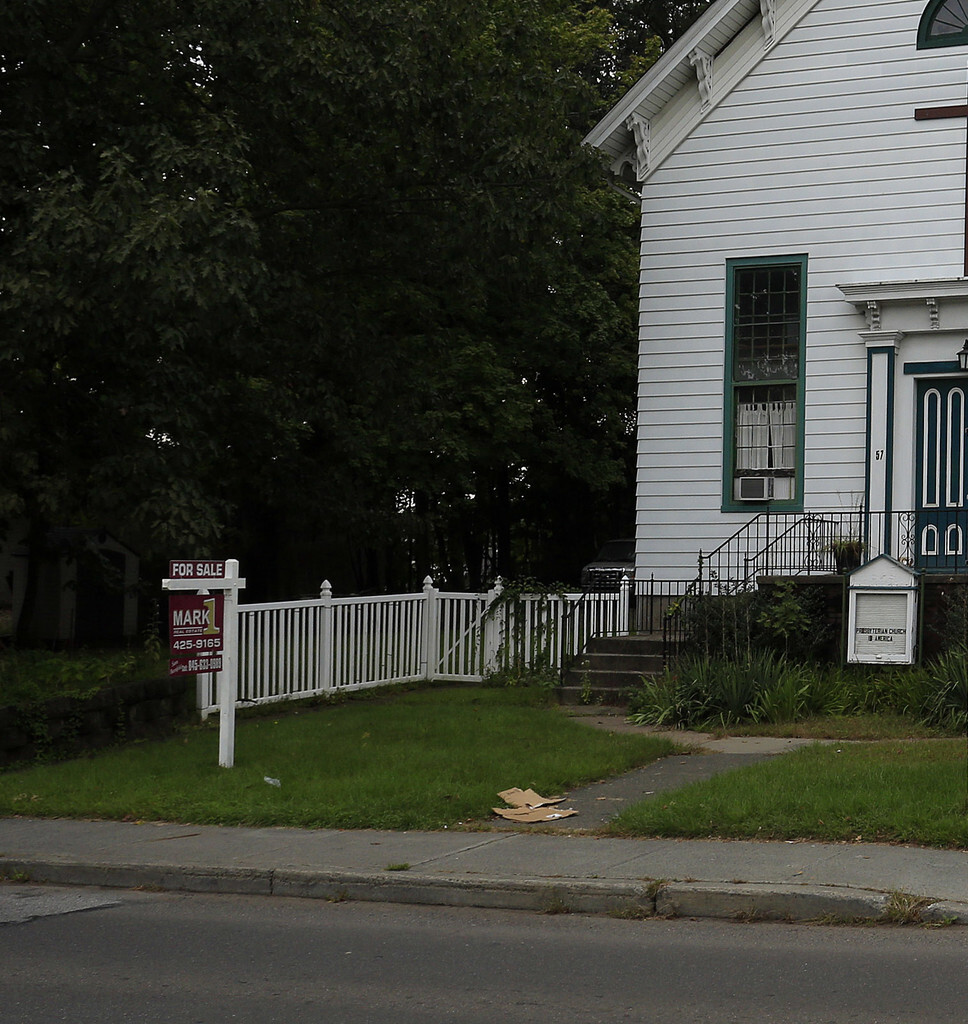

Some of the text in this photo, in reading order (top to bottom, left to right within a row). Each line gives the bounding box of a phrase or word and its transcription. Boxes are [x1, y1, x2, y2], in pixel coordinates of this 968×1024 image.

[876, 449, 884, 461] 57
[173, 563, 222, 576] FOR SALE
[173, 609, 210, 626] MARK
[173, 638, 221, 650] 425-9165
